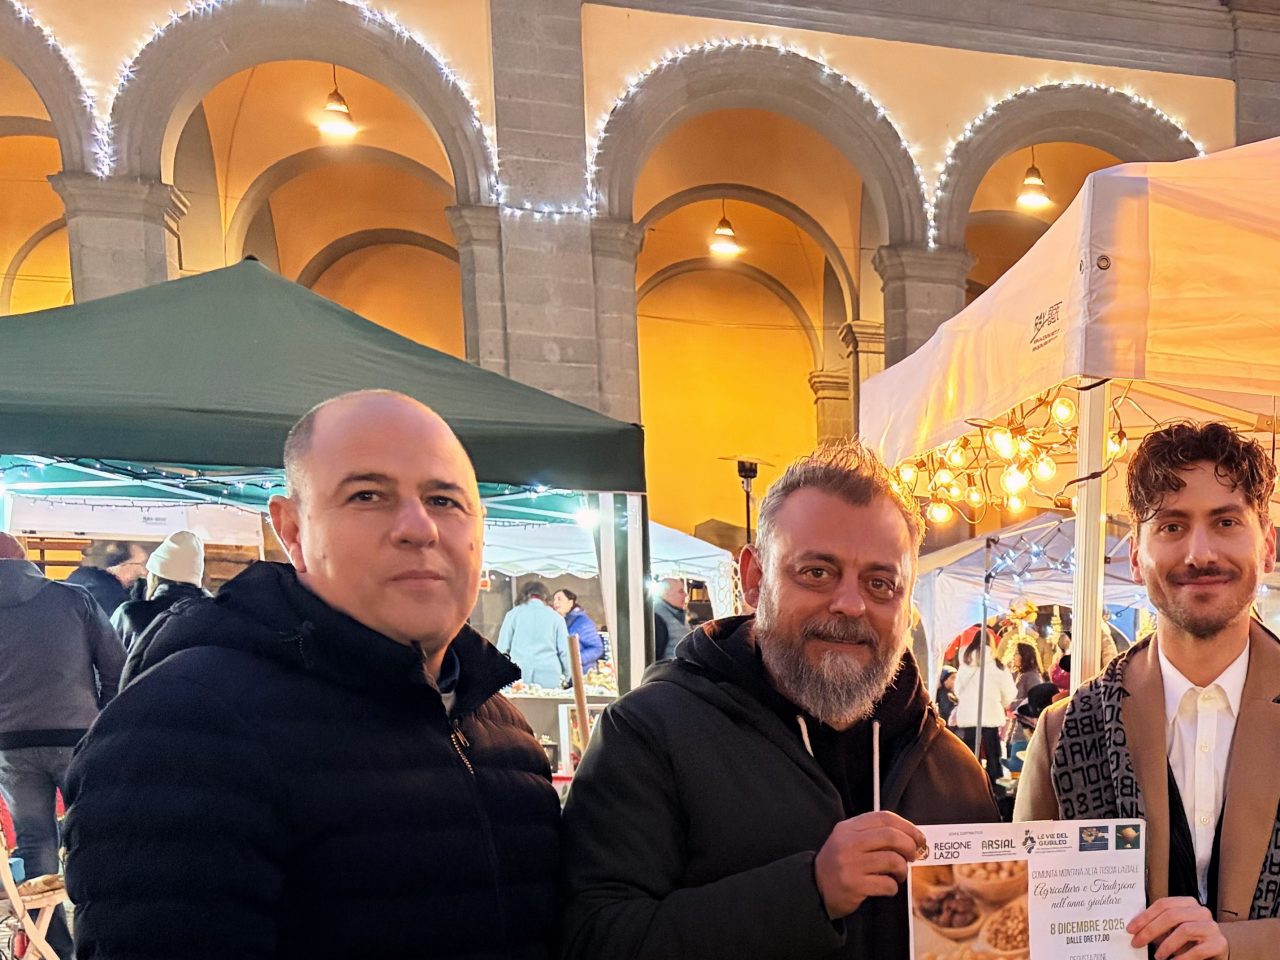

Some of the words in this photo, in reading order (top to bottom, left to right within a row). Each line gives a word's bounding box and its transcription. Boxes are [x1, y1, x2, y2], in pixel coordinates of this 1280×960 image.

[934, 841, 972, 851] REGIONE
[981, 839, 1016, 850] ARSIAL
[934, 851, 960, 860] LAZIO
[1033, 882, 1081, 900] Agricoltura
[1089, 879, 1137, 895] Tradizione
[1087, 895, 1122, 911] giubilare
[1050, 923, 1056, 935] 8
[1058, 920, 1100, 935] DICEMBRE
[1102, 918, 1125, 931] 2025
[1066, 935, 1082, 945] DALLE
[1083, 935, 1094, 943] ORE
